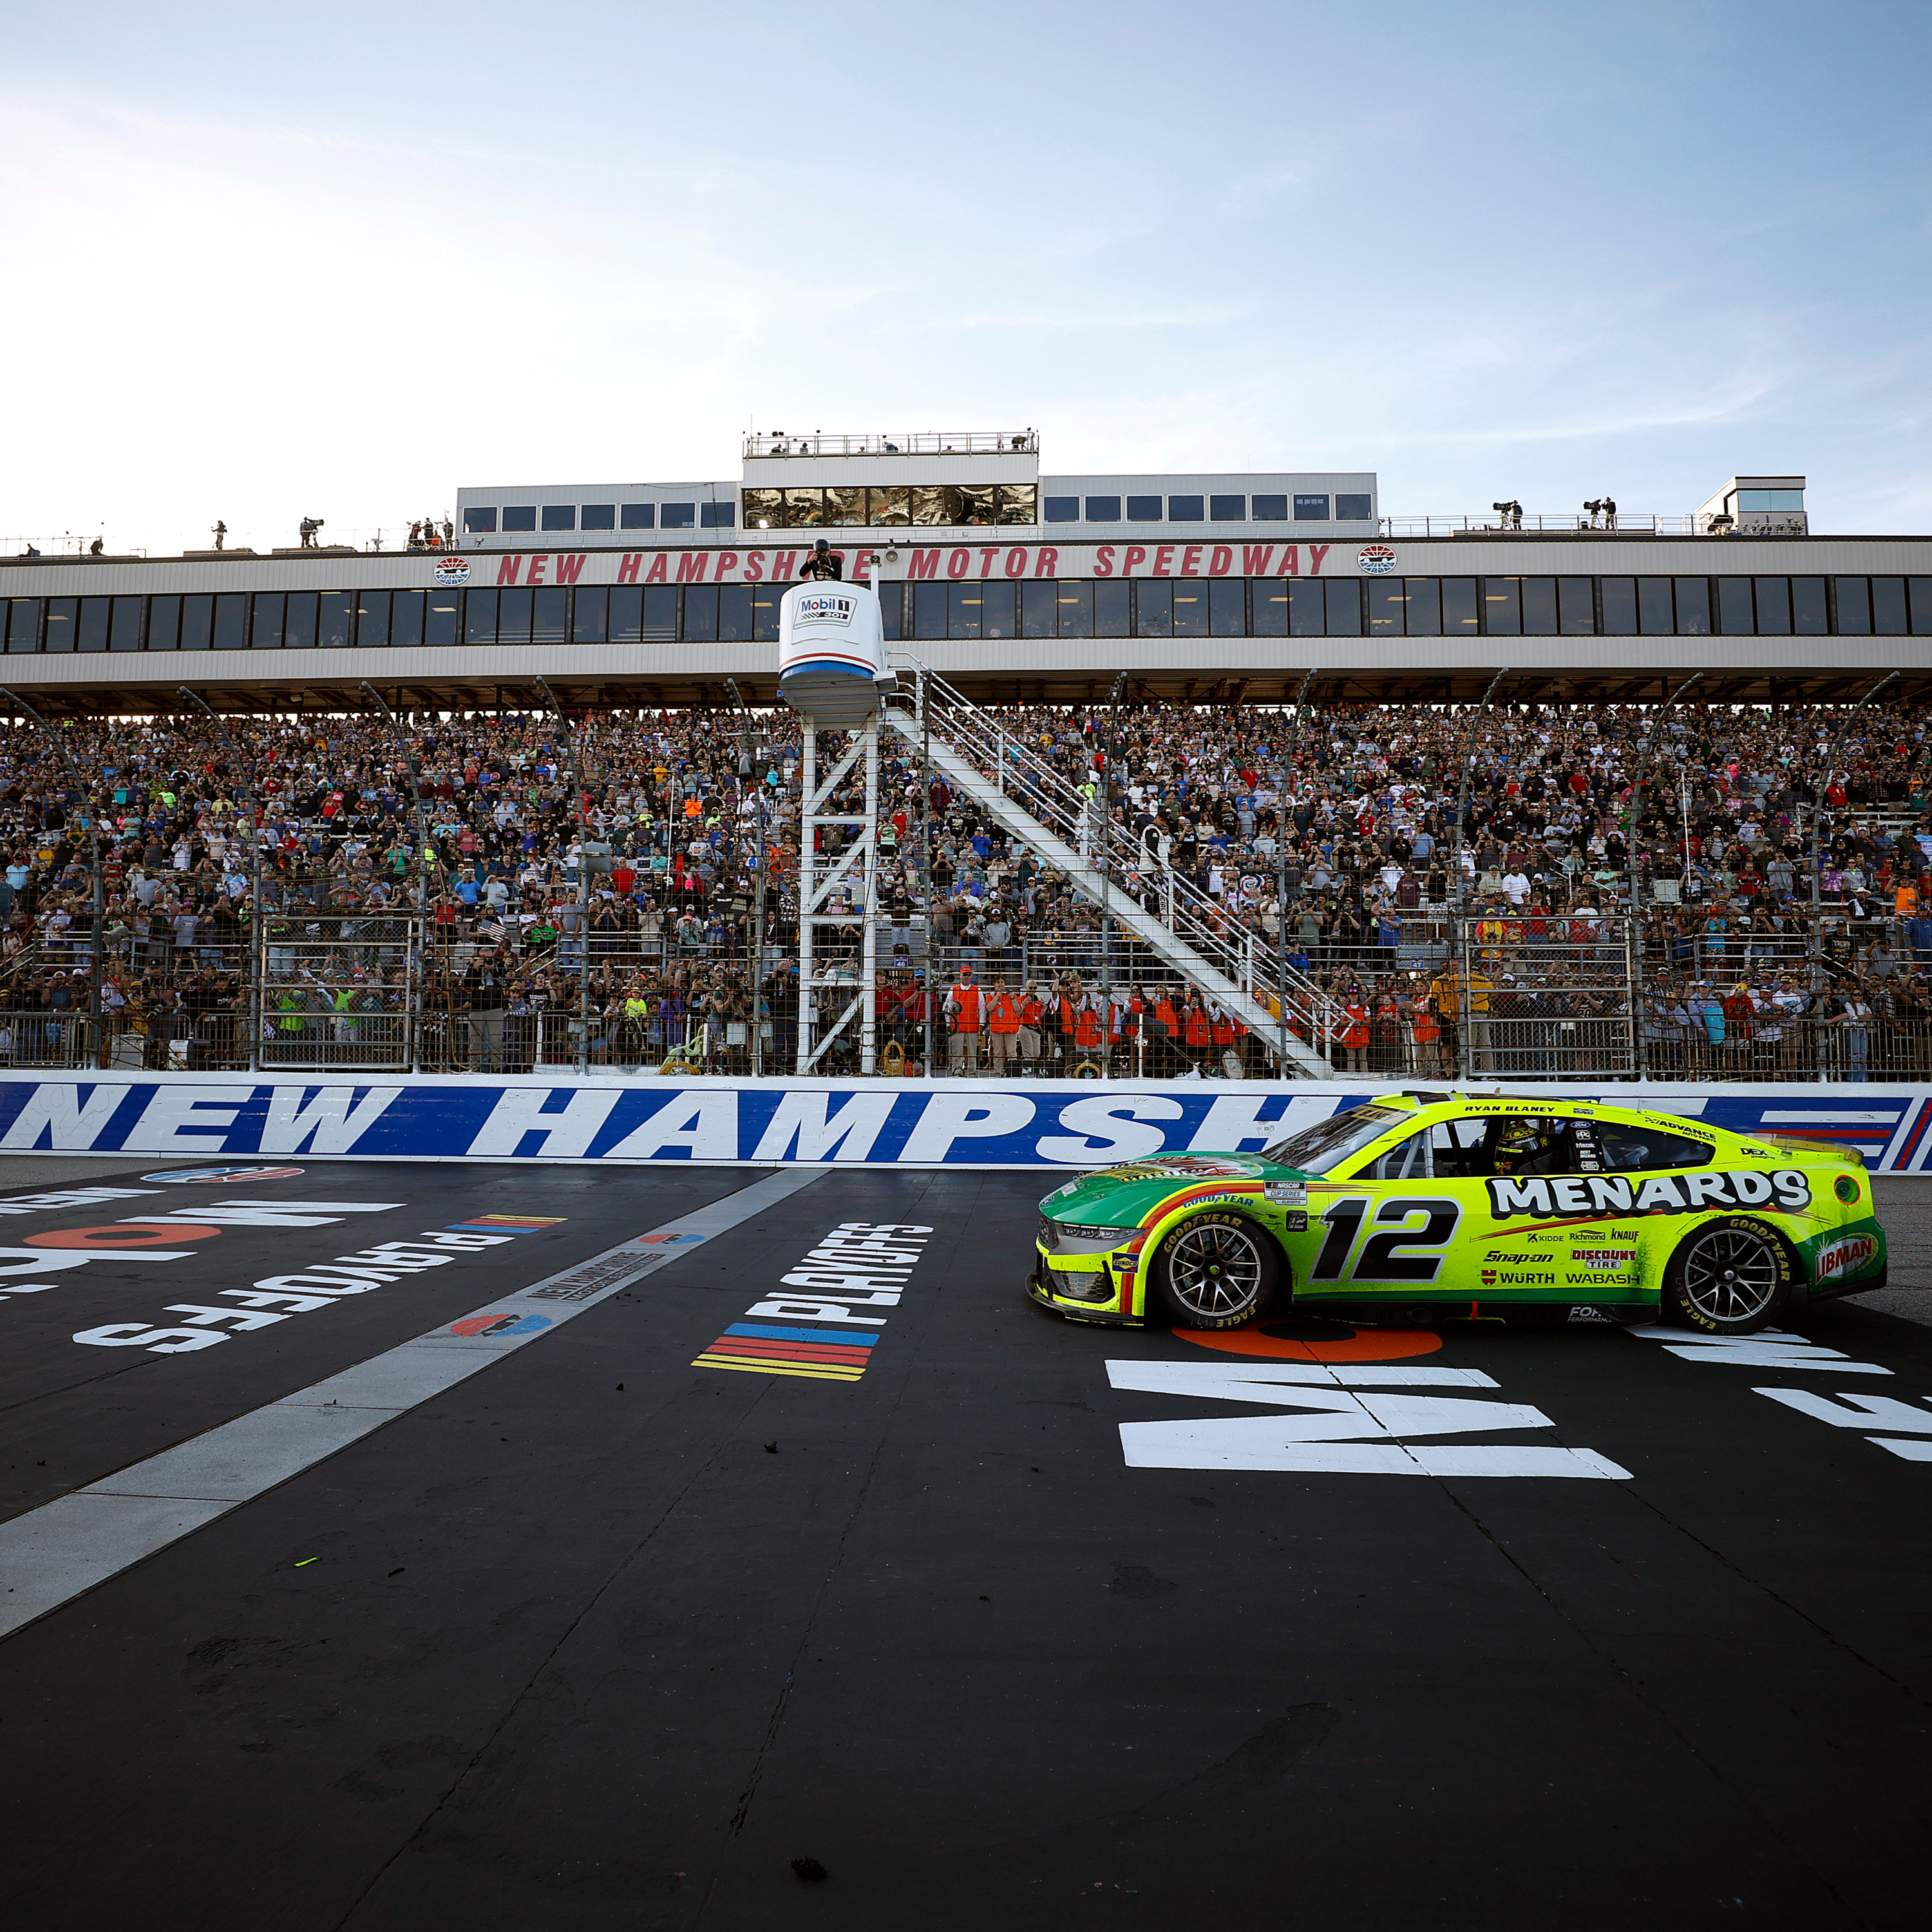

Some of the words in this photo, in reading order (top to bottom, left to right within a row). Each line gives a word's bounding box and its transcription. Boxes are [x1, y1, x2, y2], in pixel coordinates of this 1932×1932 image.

[496, 554, 587, 585] NEW
[907, 546, 1058, 579] MOTOR
[1093, 545, 1330, 577] SPEEDWAY
[802, 598, 835, 612] Mobil
[840, 600, 848, 611] 1
[0, 1084, 405, 1153] NEW
[465, 1088, 1708, 1164] HAMPSH
[1657, 1121, 1716, 1139] ADVANCE
[1183, 1192, 1254, 1208] GOODYEAR
[1488, 1170, 1810, 1214] MENARDS
[1164, 1214, 1242, 1253] GOODYEAR
[1307, 1195, 1463, 1283] 12
[1570, 1232, 1605, 1240] Richmond
[1730, 1218, 1790, 1281] GOODYEAR
[1484, 1251, 1554, 1264] Snap-on
[1571, 1249, 1636, 1260] DISCOUNT
[1815, 1237, 1873, 1285] LIBMAN
[744, 1222, 934, 1325] PLAYOFFS
[1566, 1274, 1640, 1285] WABASH
[72, 1231, 516, 1354] PLAYOFFS
[1216, 1305, 1256, 1327] EAGLE
[1680, 1299, 1717, 1330] EAGLE
